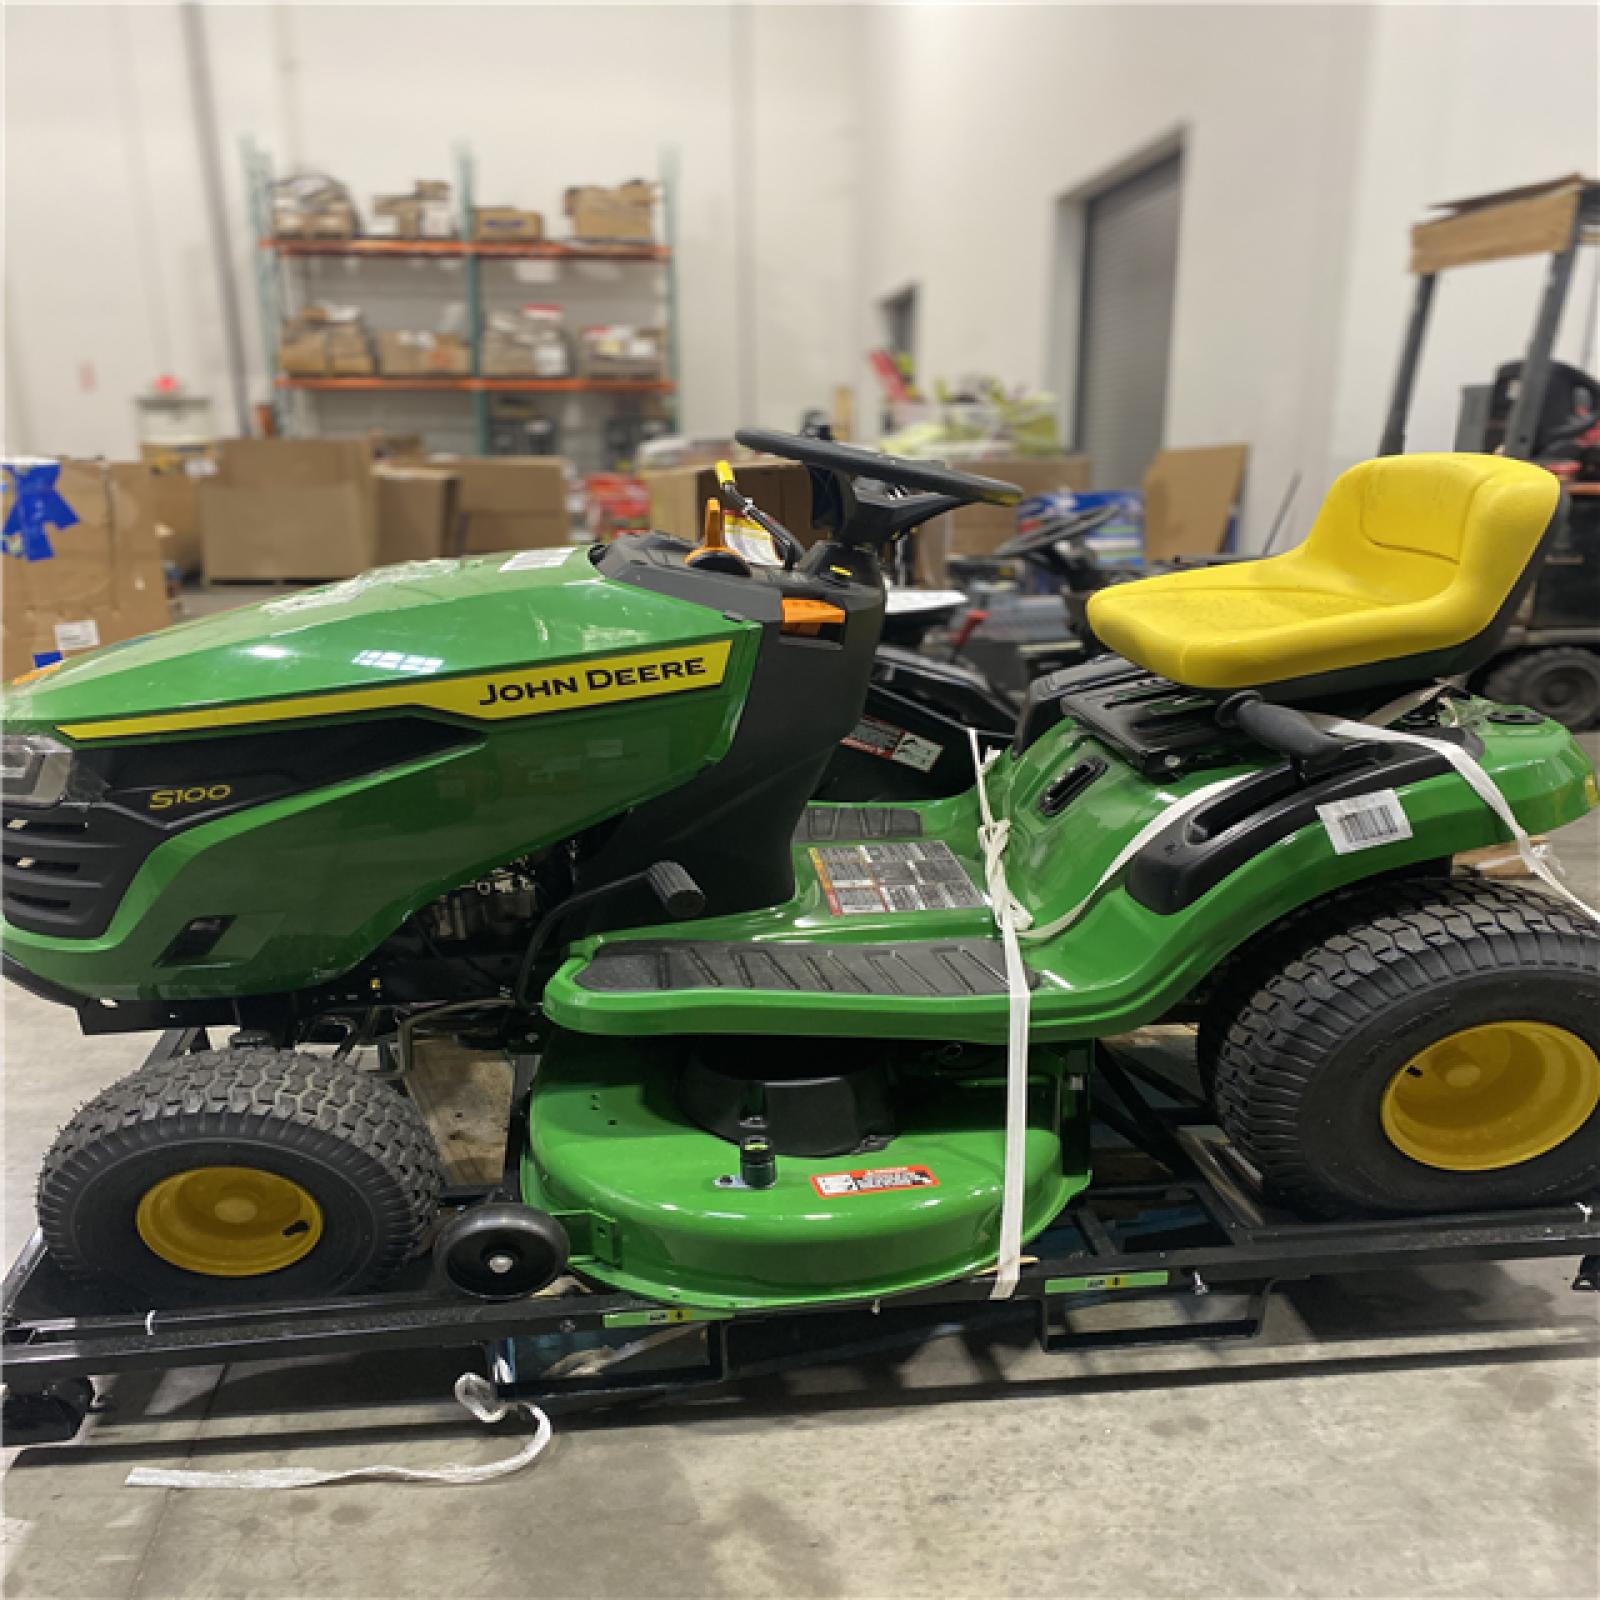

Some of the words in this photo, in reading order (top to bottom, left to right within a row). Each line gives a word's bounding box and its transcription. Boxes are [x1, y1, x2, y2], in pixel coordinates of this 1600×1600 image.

[479, 677, 578, 706] JOHN
[585, 657, 706, 691] DEERE
[149, 784, 232, 809] S100
